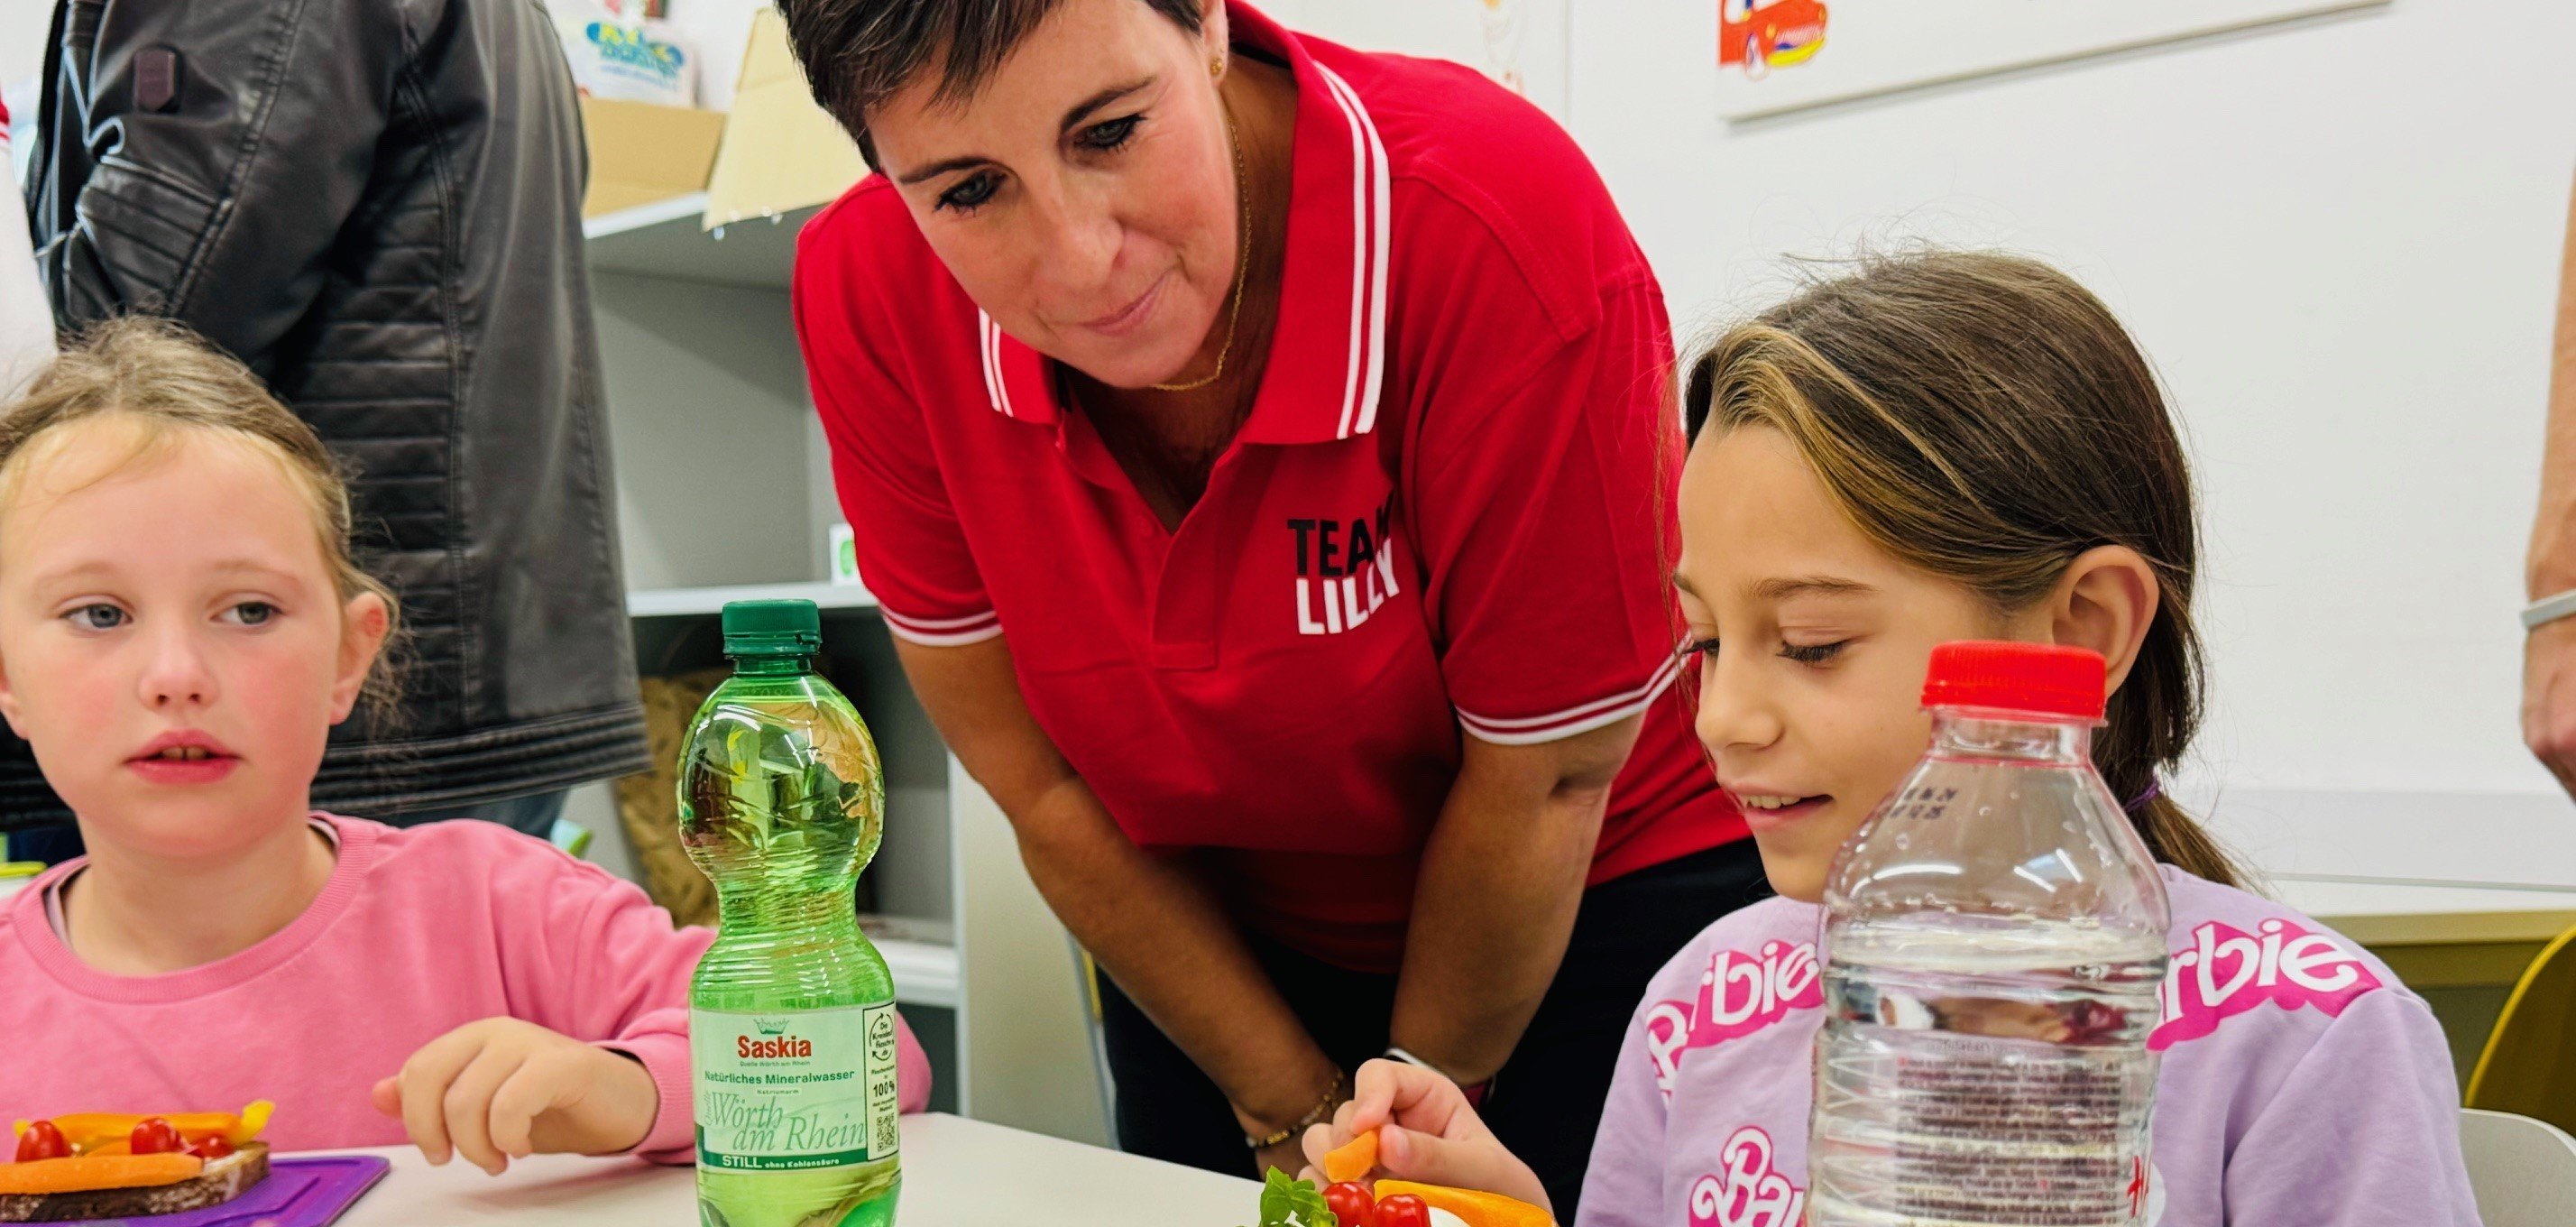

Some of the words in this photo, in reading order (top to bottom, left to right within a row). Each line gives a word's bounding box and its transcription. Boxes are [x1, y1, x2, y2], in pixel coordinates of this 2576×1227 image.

[1296, 538, 1400, 635] LILLY
[2156, 919, 2360, 1025] rbie
[737, 1035, 812, 1059] Saskia
[704, 1070, 762, 1084] Natürliches
[766, 1070, 855, 1084] Mineralwasser
[712, 1092, 783, 1130] Wörth
[785, 1113, 866, 1151] Rhein
[722, 1155, 763, 1168] STILL
[765, 1160, 786, 1168] ohne
